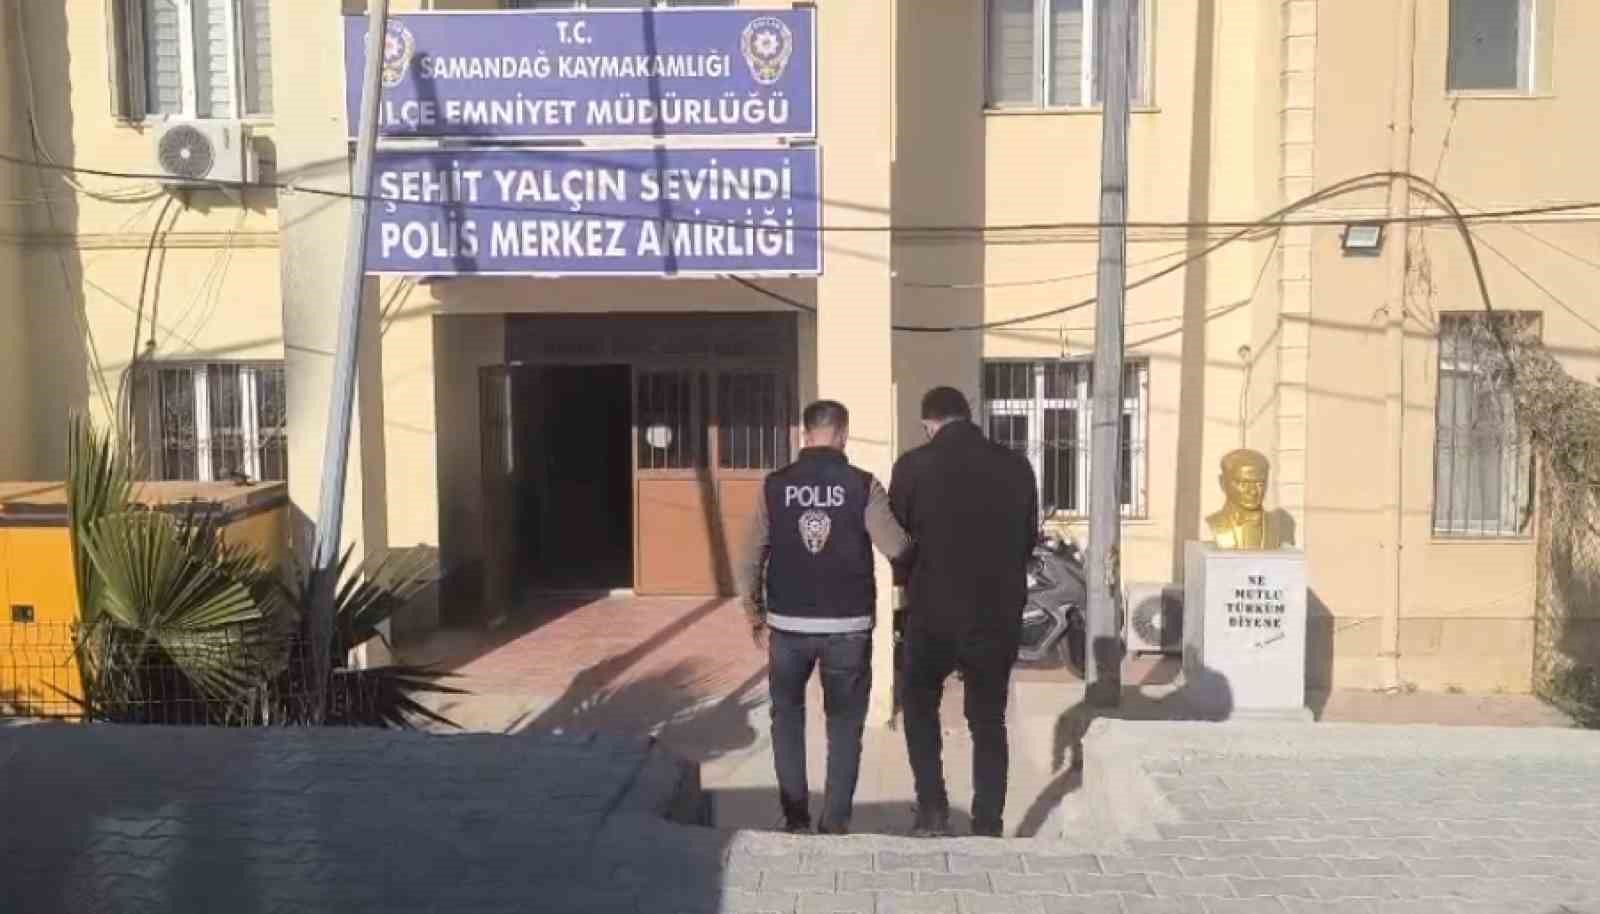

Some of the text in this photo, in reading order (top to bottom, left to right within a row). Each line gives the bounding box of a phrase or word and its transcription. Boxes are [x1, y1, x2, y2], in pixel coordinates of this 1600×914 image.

[556, 20, 592, 44] T.C.
[421, 49, 731, 79] SAMANDAĞ KAYMAKAMLIĞI
[446, 91, 576, 125] EMNİYET
[586, 91, 789, 125] MÜDÜRLÜĞÜ
[380, 158, 792, 213] ŞEHİT YALÇIN SEVİNDİ
[381, 208, 794, 259] POLİS MERKEZ AMİRLİĞİ
[785, 485, 845, 507] POLIS
